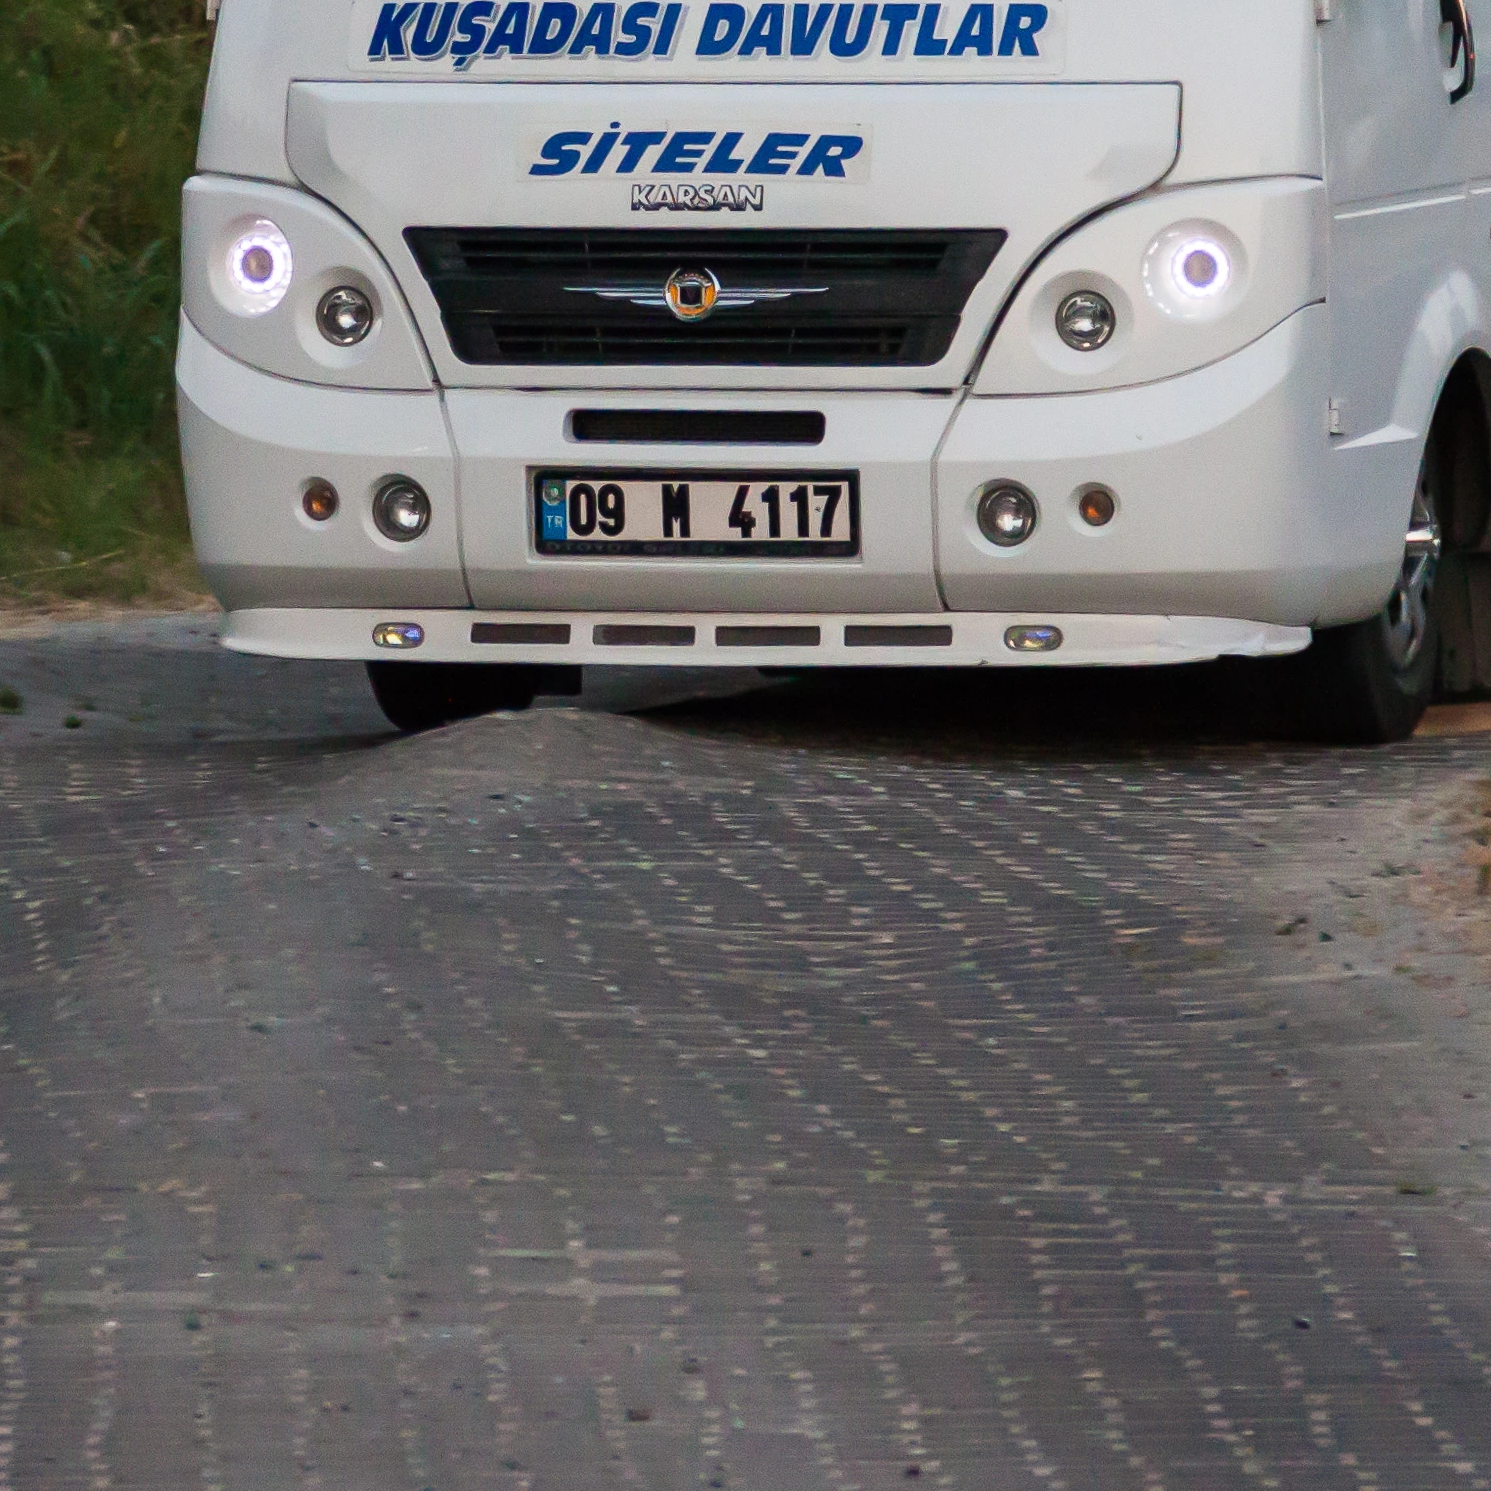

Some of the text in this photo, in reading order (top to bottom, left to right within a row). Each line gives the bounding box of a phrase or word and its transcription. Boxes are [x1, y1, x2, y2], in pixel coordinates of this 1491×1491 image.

[367, 1, 1050, 73] KUŞADASI DAVUTLAR
[630, 184, 764, 212] KARSAN
[546, 482, 843, 539] TR 09 M 4117
